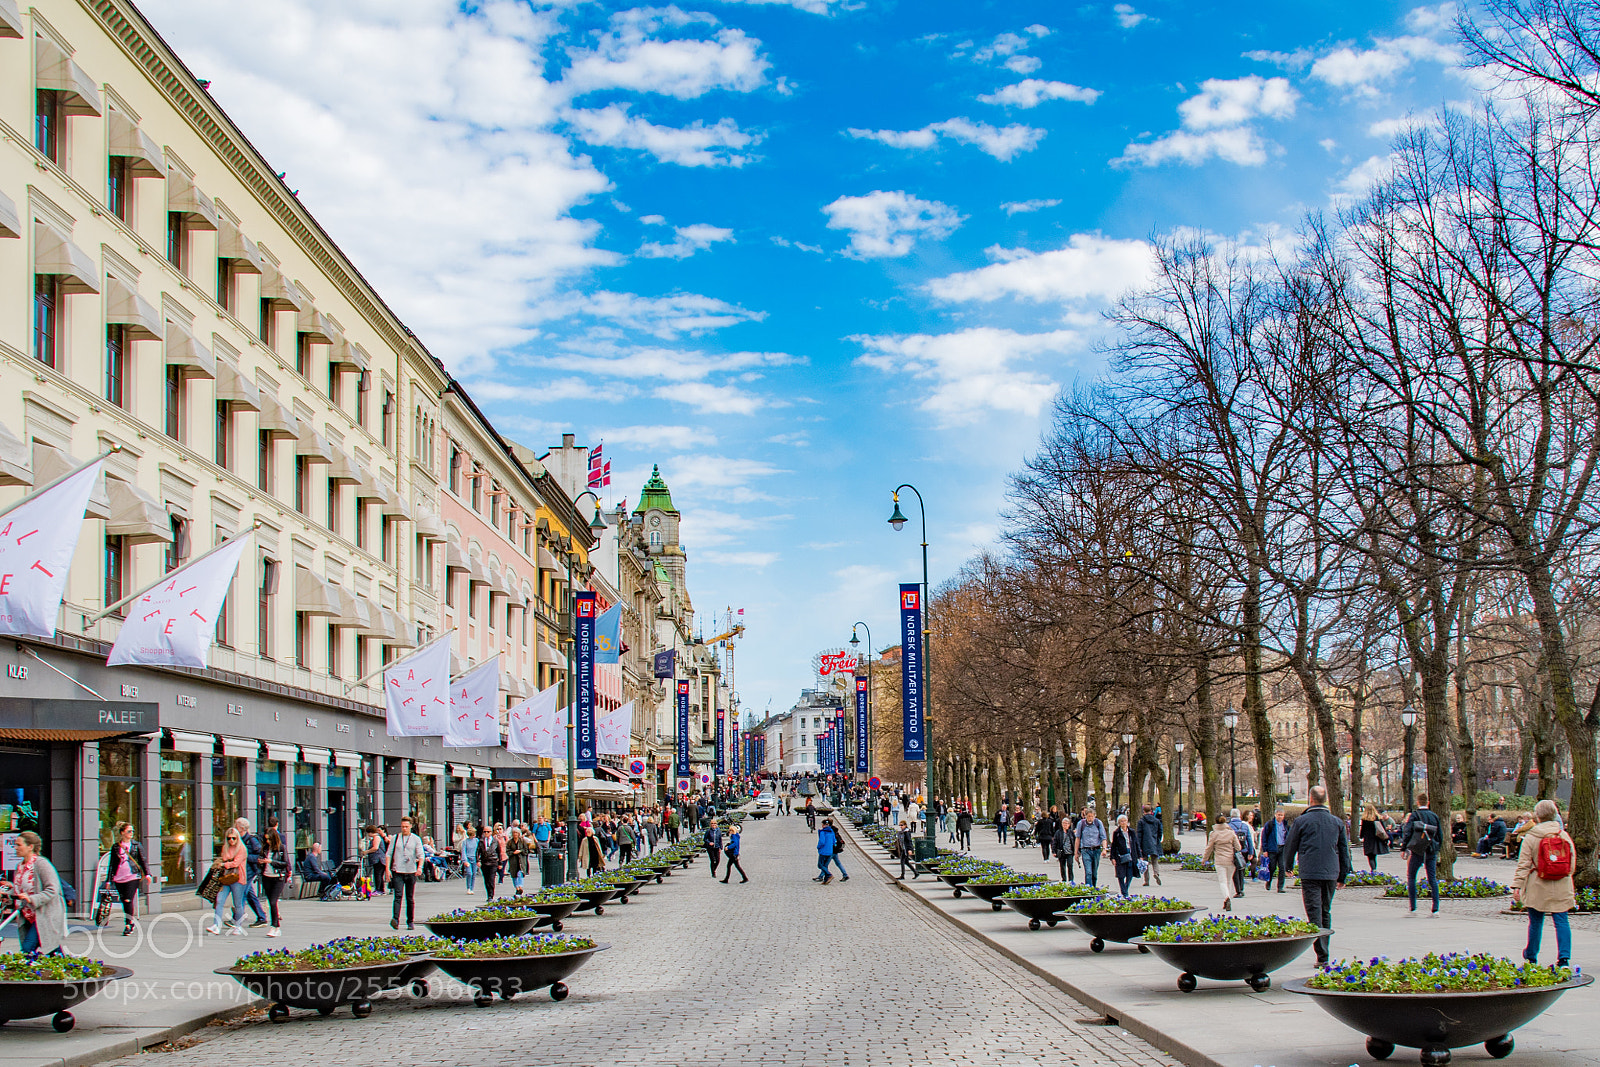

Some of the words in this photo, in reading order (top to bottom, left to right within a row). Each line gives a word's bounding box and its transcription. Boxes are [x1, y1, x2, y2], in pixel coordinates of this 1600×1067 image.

[580, 623, 590, 658] NORSK
[906, 615, 916, 650] NORSK
[140, 646, 176, 656] Shopping
[819, 650, 858, 676] Freia
[8, 663, 29, 680] KLÆR
[581, 661, 590, 704] MILITÆR
[908, 652, 918, 695] MILITÆR
[99, 709, 145, 724] PALEET
[581, 706, 590, 742] TATTOO
[909, 697, 918, 733] TATTOO
